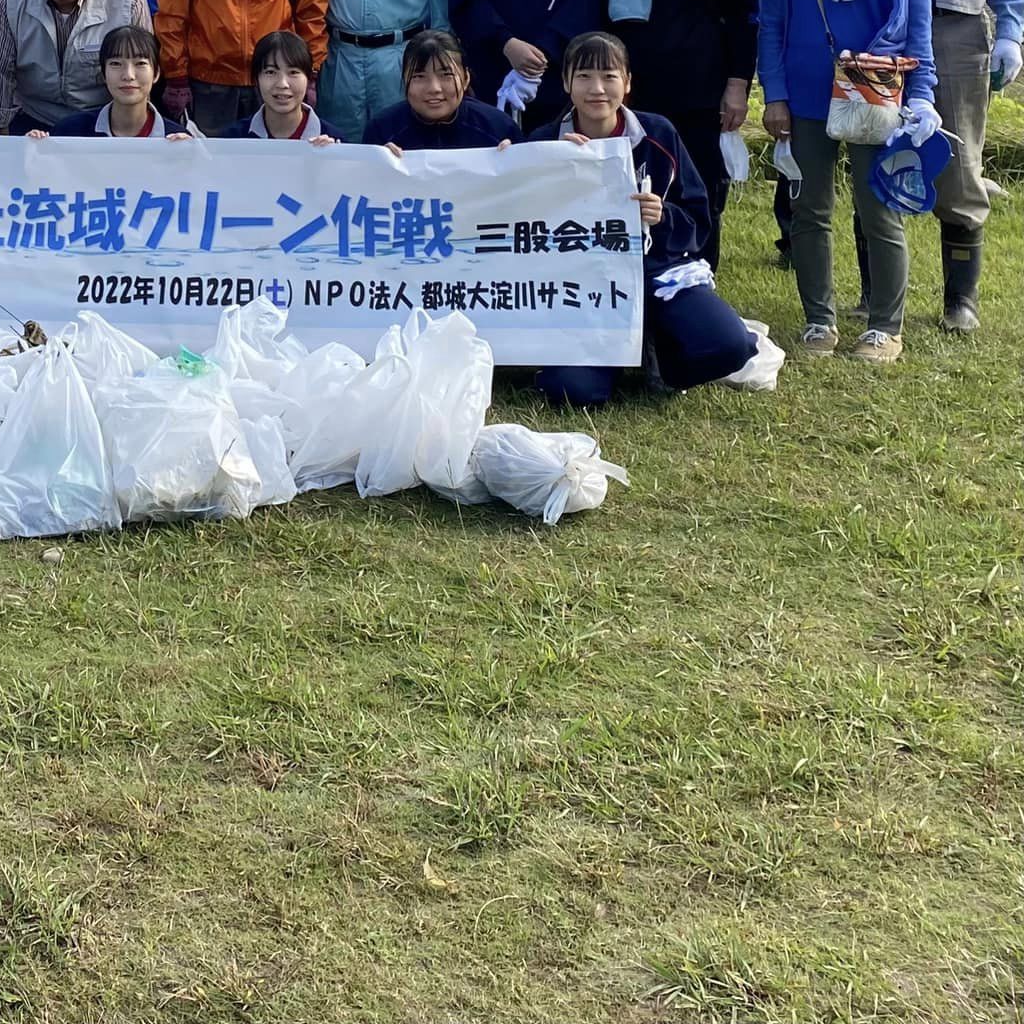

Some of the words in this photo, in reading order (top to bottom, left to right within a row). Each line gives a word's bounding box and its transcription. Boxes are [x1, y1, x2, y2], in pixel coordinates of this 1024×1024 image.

[475, 218, 630, 255] 三股会場
[304, 280, 414, 310] NPO法人
[421, 281, 628, 310] 都城大淀川サミット
